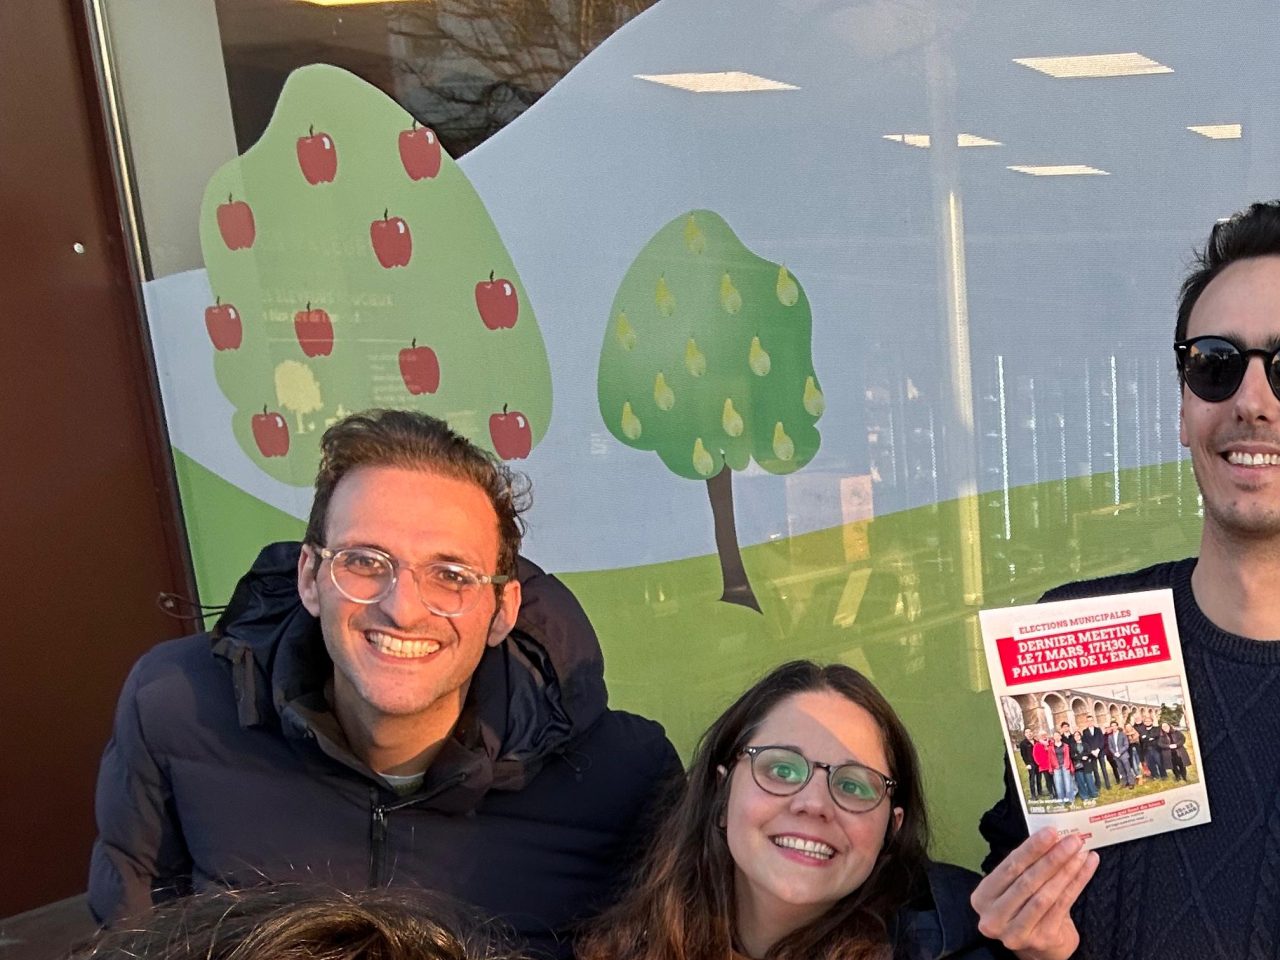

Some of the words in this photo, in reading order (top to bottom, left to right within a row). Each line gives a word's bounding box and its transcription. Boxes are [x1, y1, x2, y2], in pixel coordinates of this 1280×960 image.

[1019, 620, 1068, 635] ELECTIONS
[1070, 610, 1132, 626] MUNICIPALES
[1017, 654, 1034, 665] LE
[1035, 652, 1042, 662] 7
[1046, 645, 1088, 660] MARS,
[1088, 640, 1130, 654] 17H30,
[1131, 635, 1149, 647] AU
[1018, 635, 1075, 653] DERNIER
[1075, 624, 1141, 643] MEETING
[1012, 658, 1078, 678] PAVILLON
[1080, 655, 1097, 667] DE
[1099, 645, 1161, 664] L'ÉRABLE
